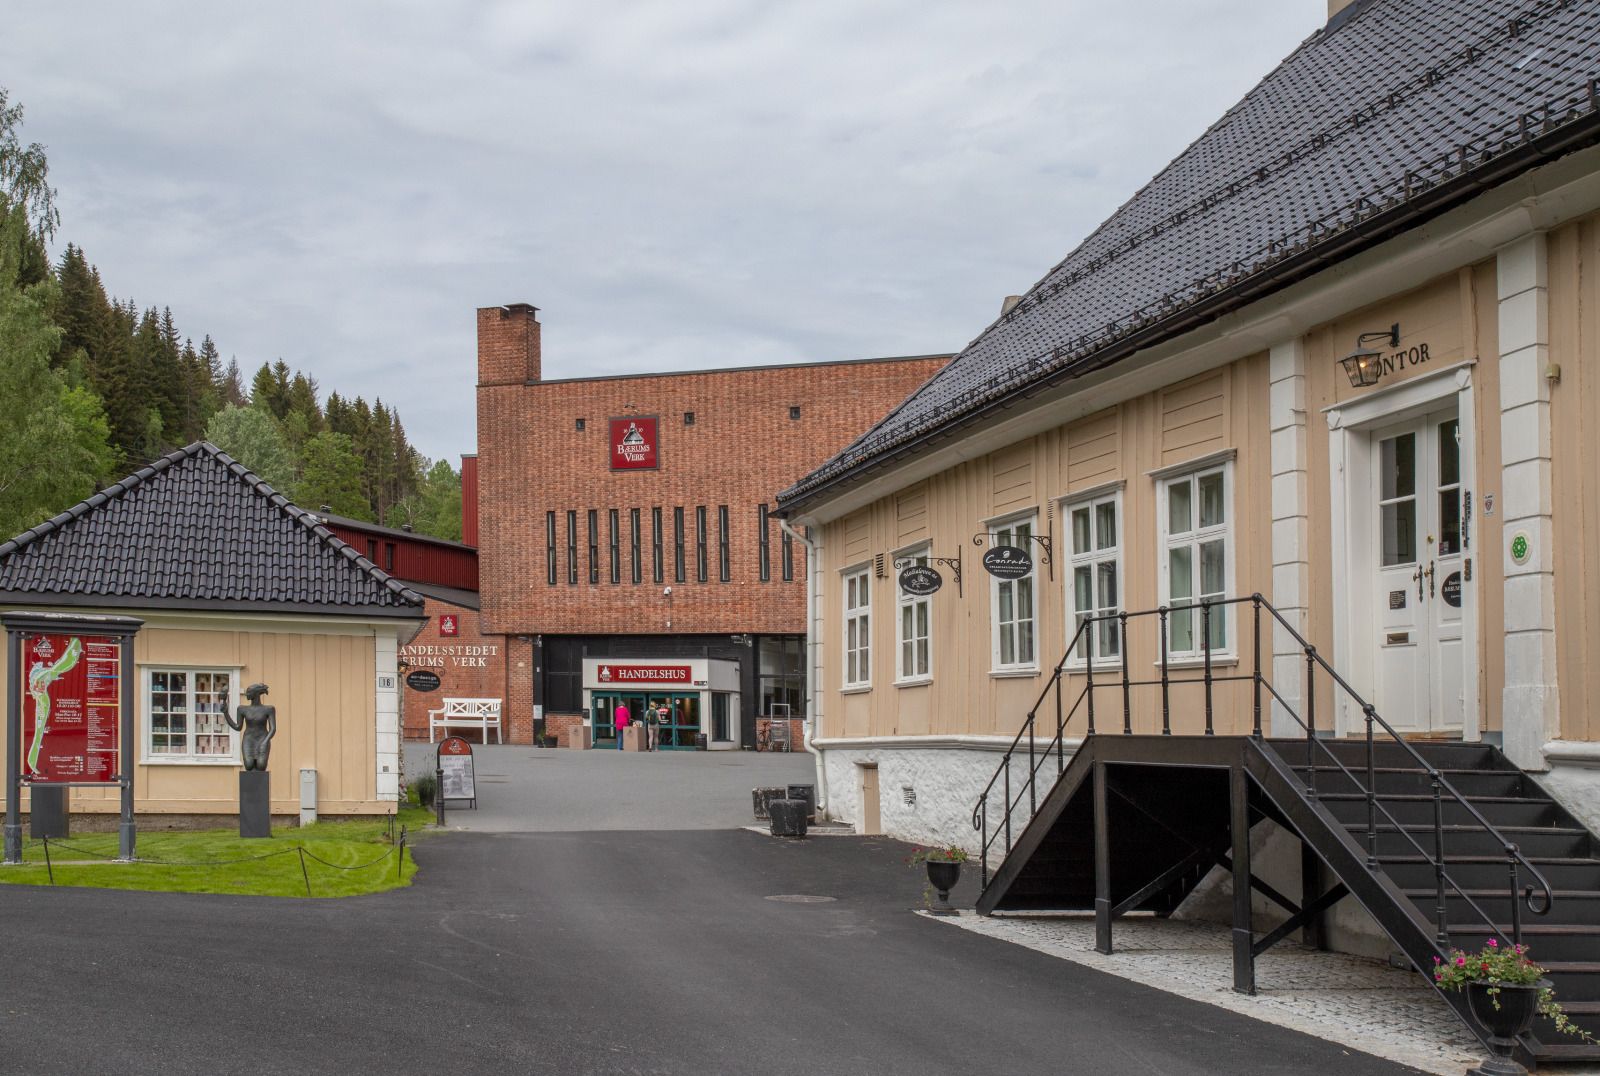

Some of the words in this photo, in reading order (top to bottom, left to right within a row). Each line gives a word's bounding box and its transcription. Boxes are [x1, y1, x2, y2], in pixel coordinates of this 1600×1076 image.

[617, 444, 650, 455] BÆRUMS
[624, 453, 645, 462] VERK
[399, 645, 498, 656] ANDELSSTEDET
[452, 656, 487, 667] VERK
[619, 669, 686, 679] HANDELSHUS
[383, 678, 391, 687] 16
